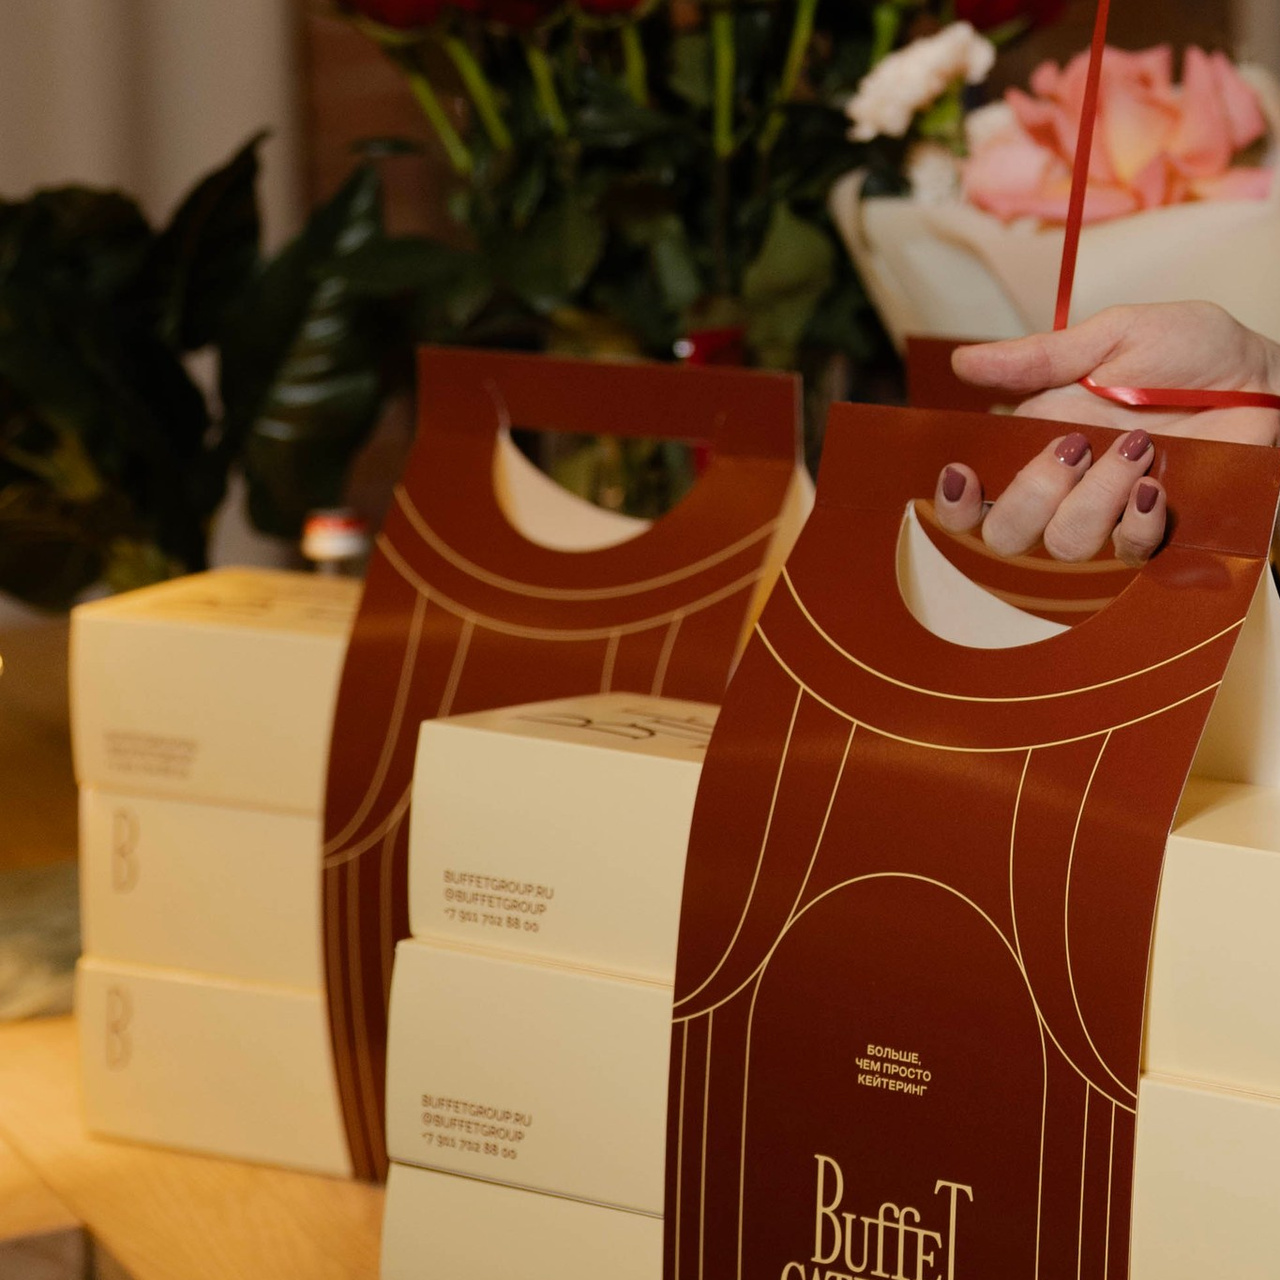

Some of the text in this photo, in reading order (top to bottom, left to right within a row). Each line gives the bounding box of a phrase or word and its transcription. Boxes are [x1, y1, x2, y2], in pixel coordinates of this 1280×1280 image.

[443, 869, 555, 900] BUFFETGROUP.RU
[444, 887, 547, 916] @BUFFETGROUP
[855, 1057, 932, 1082] ЧЕМ ПРОСТО
[866, 1044, 922, 1066] БОЛЬШЕ,
[857, 1073, 928, 1096] КЕЙТЕРИНГ
[422, 1094, 533, 1127] BUFFETGROUP.RU
[422, 1111, 525, 1142] @BUFFETGROUP
